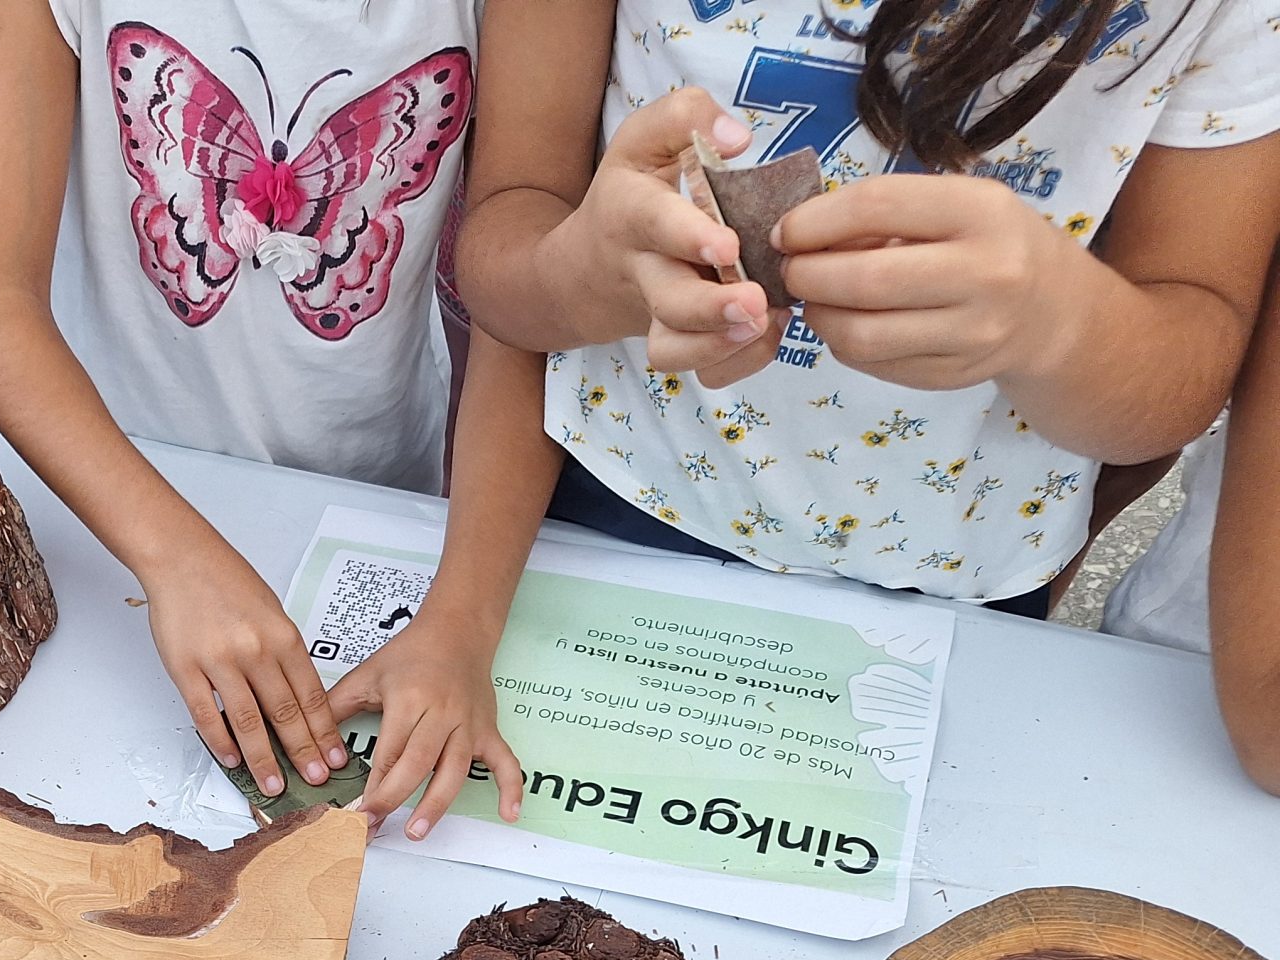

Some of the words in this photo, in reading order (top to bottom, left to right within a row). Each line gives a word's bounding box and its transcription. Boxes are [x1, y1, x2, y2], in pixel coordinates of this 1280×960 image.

[775, 345, 819, 369] RIOR
[555, 638, 569, 652] y
[586, 628, 638, 650] cada
[631, 616, 794, 656] descubrimiento.
[644, 640, 669, 654] en
[573, 644, 618, 665] lista
[624, 654, 707, 679] nuestra
[675, 644, 828, 683] acompáñanos
[714, 671, 728, 682] a
[494, 676, 572, 703] familias
[579, 687, 638, 712] niños,
[636, 675, 737, 705] docentes.
[735, 676, 840, 705] Apúntate
[742, 694, 756, 707] y
[513, 703, 532, 719] la
[646, 700, 671, 717] en
[538, 707, 672, 744] despertando
[678, 705, 774, 738] científica
[679, 731, 732, 753] años
[739, 741, 766, 760] 20
[780, 727, 896, 763] curiosidad
[773, 748, 801, 767] de
[807, 757, 853, 780] Más
[346, 732, 643, 825] Eduan
[660, 797, 880, 875] Ginkgo
